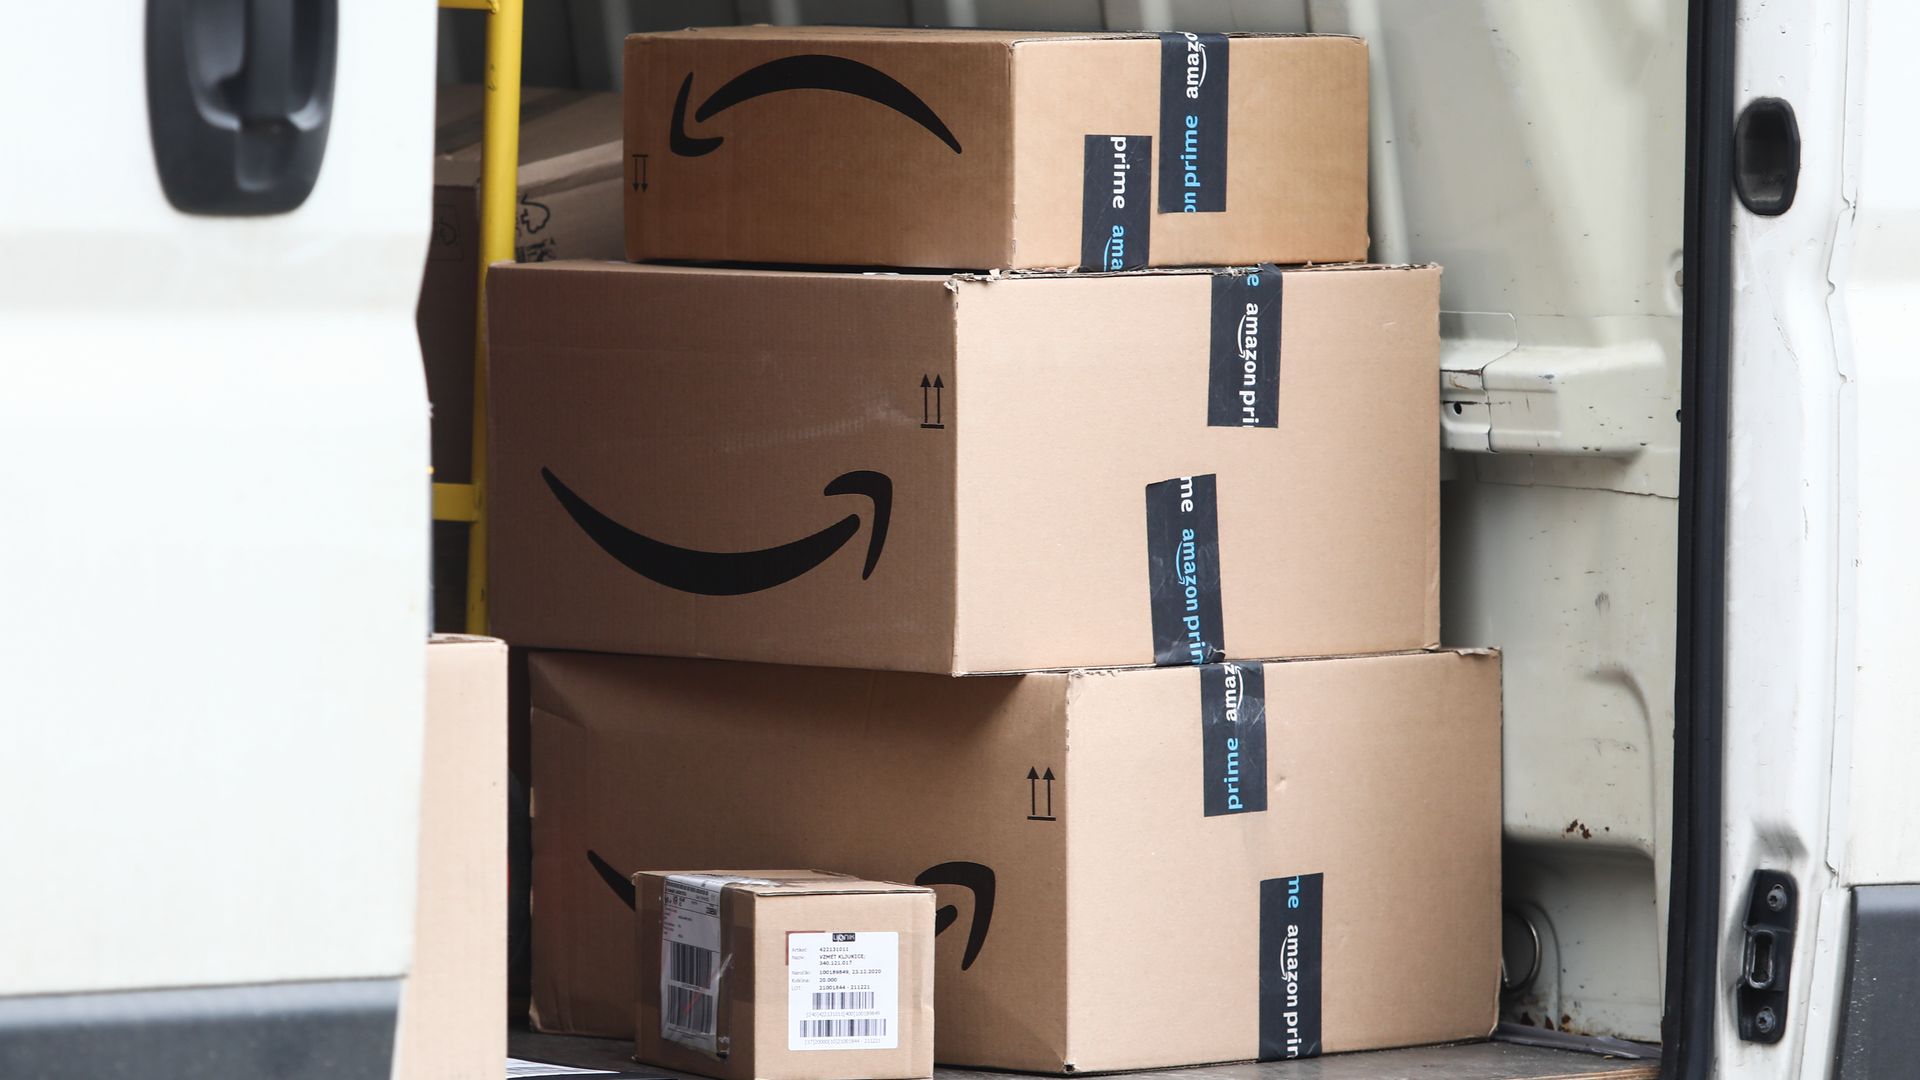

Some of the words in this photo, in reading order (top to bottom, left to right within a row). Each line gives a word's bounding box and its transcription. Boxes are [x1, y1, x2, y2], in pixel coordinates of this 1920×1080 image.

[1184, 32, 1203, 99] amazo
[1110, 136, 1130, 209] prime
[1179, 115, 1201, 187] prime
[1108, 225, 1125, 271] ama
[1241, 302, 1260, 386] amazon
[1238, 390, 1260, 428] pri
[1179, 528, 1200, 611] amazon
[1223, 663, 1241, 722] amaz
[1223, 737, 1243, 810] prime
[1283, 924, 1302, 1007] amazon
